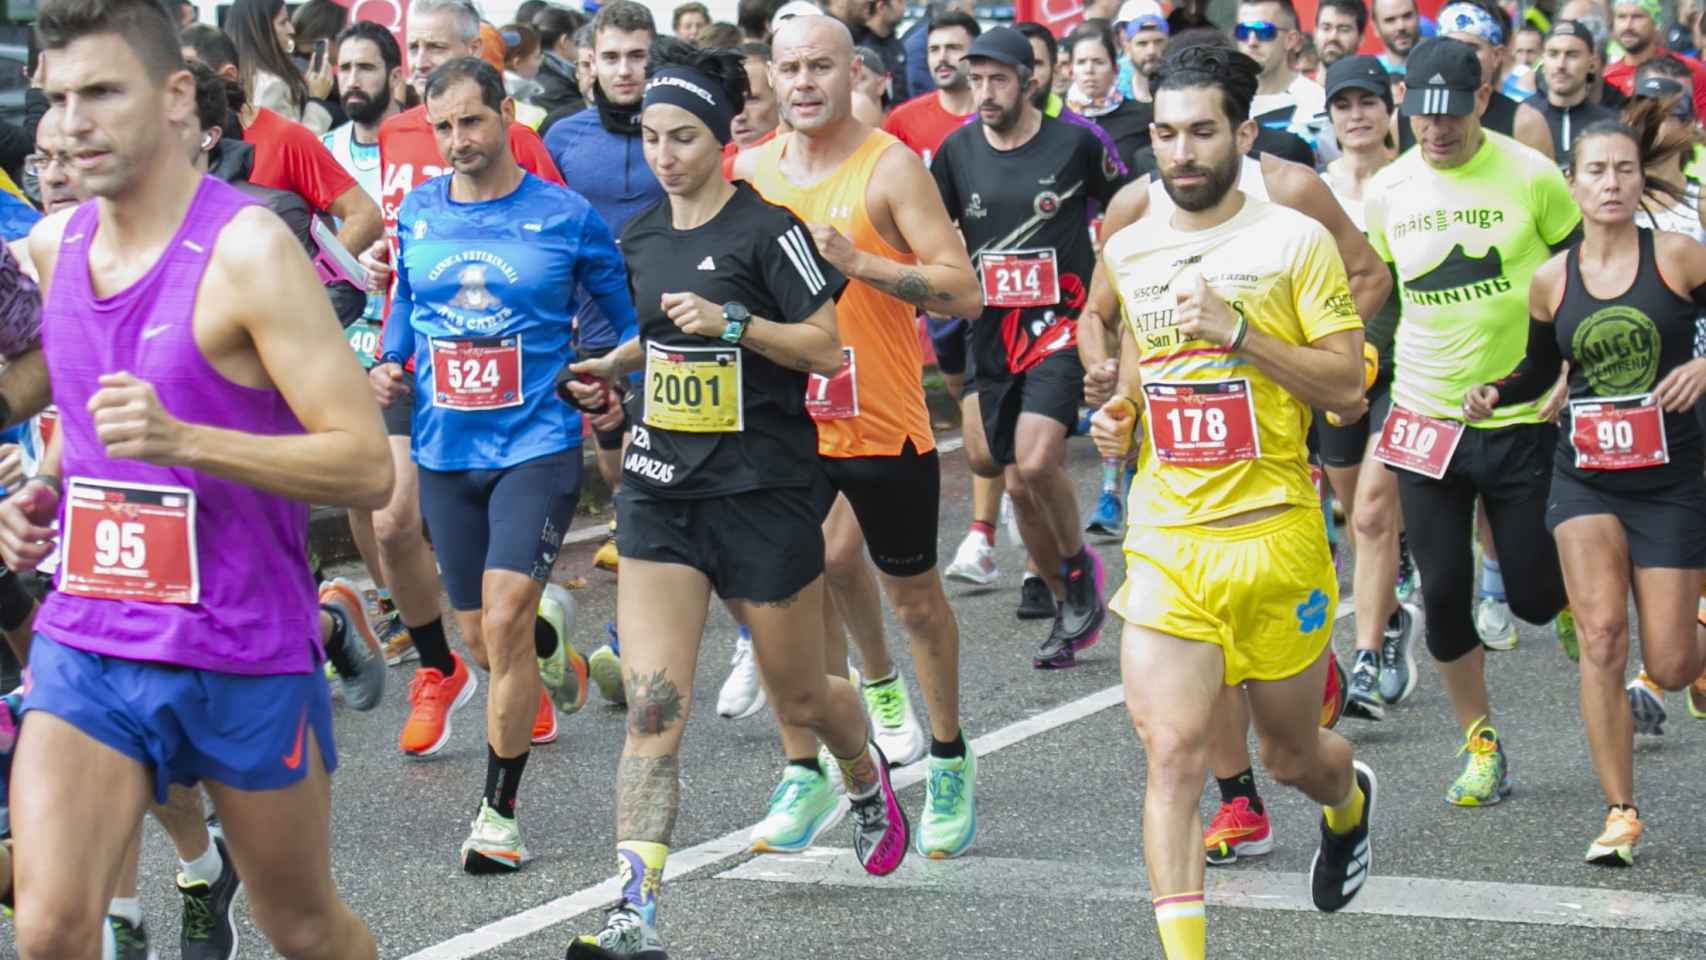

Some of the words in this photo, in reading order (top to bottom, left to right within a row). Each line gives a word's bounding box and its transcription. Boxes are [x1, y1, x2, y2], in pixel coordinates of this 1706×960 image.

[1453, 208, 1504, 229] auga
[996, 267, 1040, 292] 214
[1146, 333, 1170, 350] San
[447, 359, 500, 389] 524
[653, 371, 720, 407] 2001
[1166, 407, 1227, 443] 178
[1391, 418, 1438, 457] 510
[1597, 420, 1633, 450] 90
[94, 519, 146, 569] 95
